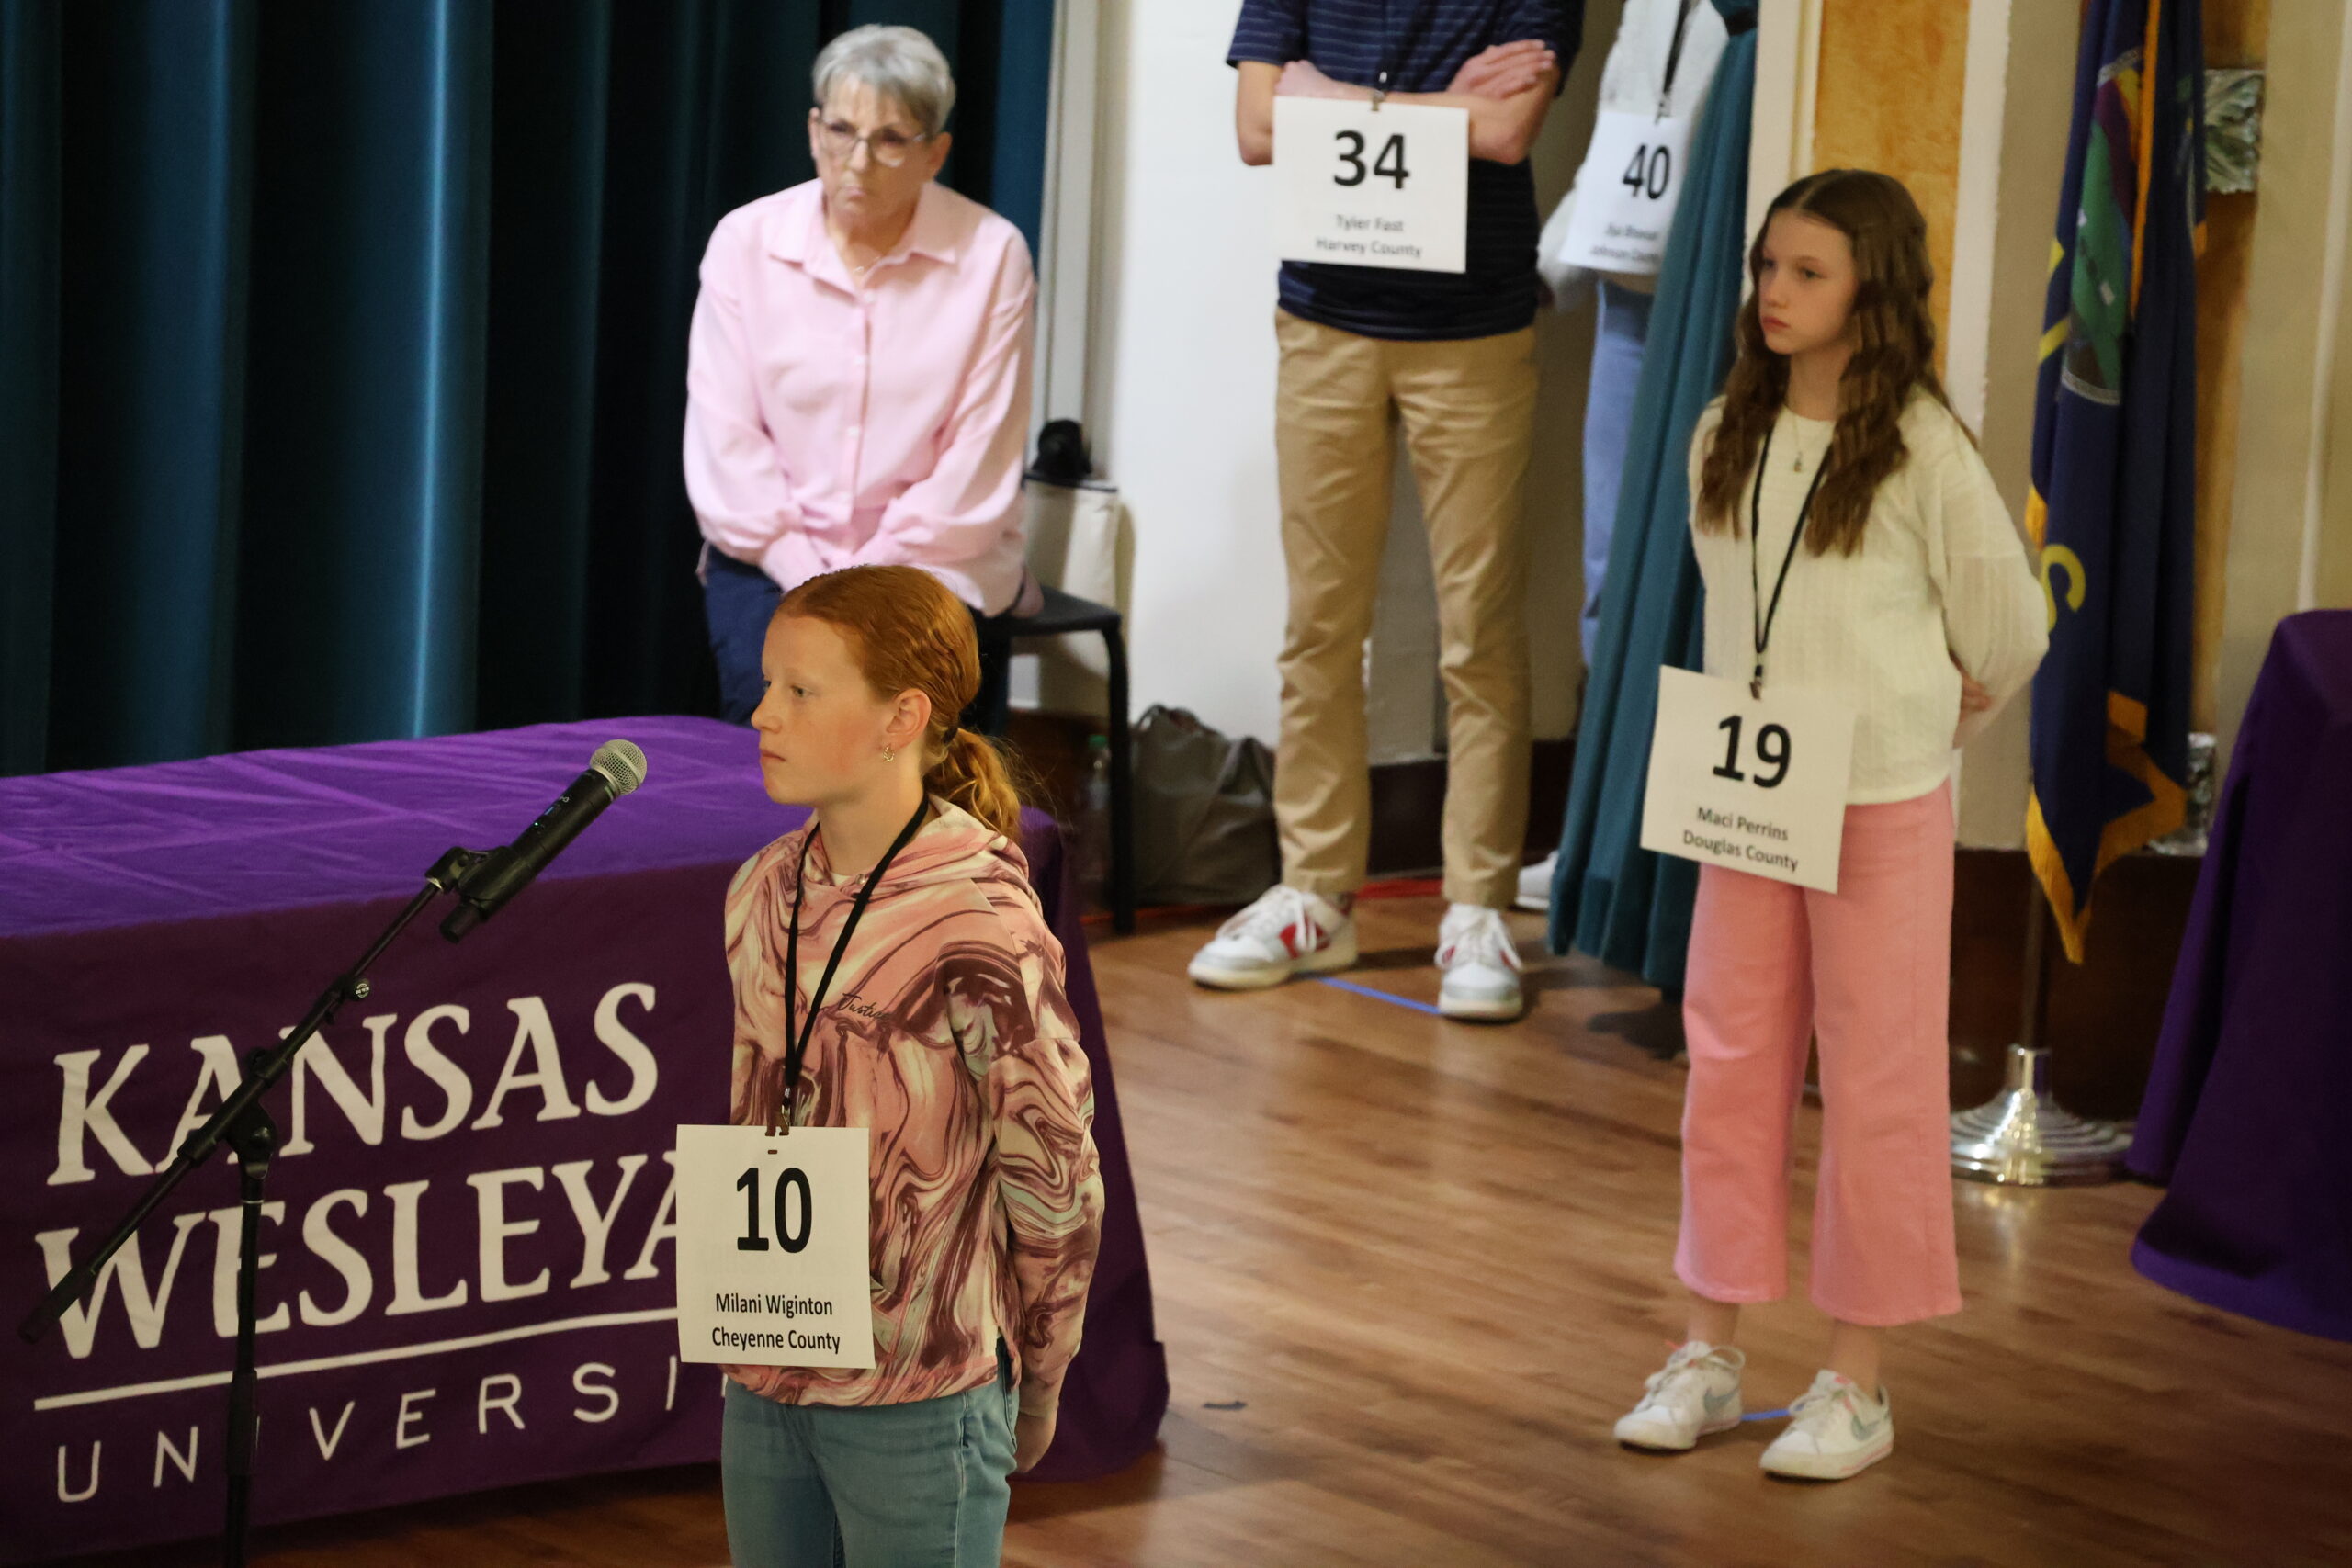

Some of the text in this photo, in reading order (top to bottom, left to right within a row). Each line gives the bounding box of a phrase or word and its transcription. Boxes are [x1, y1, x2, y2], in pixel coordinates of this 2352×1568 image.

[1333, 130, 1409, 189] 34
[1623, 144, 1670, 200] 40
[1336, 214, 1404, 231] Tyler Fast
[1316, 237, 1421, 259] Harvey County
[1713, 715, 1791, 789] 19
[1697, 807, 1789, 841] Maci Perrins
[1683, 829, 1798, 873] Douglas County
[46, 982, 659, 1185] KANSAS
[737, 1167, 811, 1253] 10
[715, 1293, 832, 1318] Milani Wiginton
[712, 1325, 841, 1354] Cheyenne County
